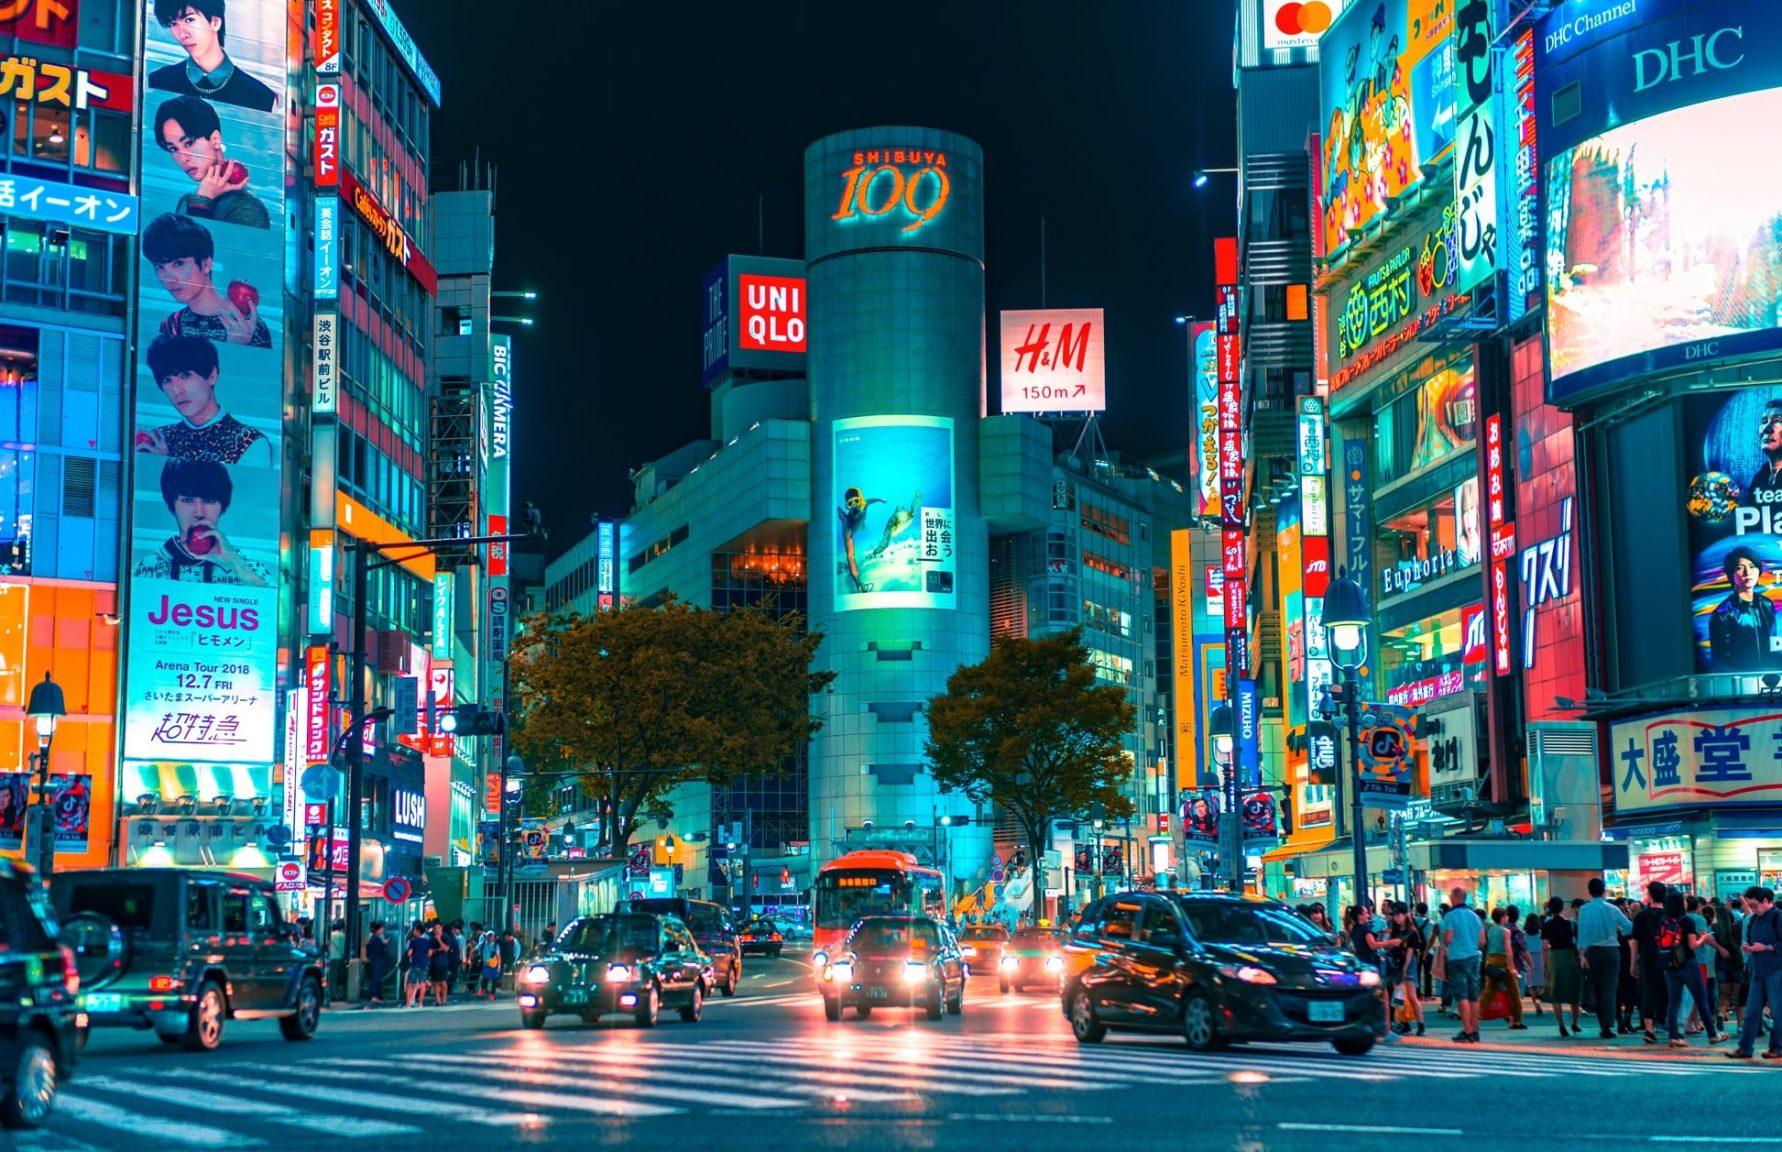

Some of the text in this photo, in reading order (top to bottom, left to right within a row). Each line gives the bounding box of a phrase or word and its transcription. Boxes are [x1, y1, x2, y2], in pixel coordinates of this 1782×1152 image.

[1545, 0, 1637, 54] DHC Channel
[325, 62, 337, 71] 8F
[1632, 26, 1744, 93] DHC
[0, 57, 108, 110] ガスト
[320, 127, 335, 175] ガスト
[852, 150, 947, 166] SHIBUYA
[831, 164, 950, 232] 109
[320, 207, 333, 288] 英会話イーオン
[748, 284, 799, 313] UNI
[748, 314, 805, 345] QLO
[318, 320, 332, 405] 渋谷駅前ビル
[1014, 321, 1092, 374] H&M
[1685, 341, 1719, 360] DHC
[493, 345, 514, 458] BIC CAMERA
[925, 518, 952, 530] 世界に
[925, 531, 952, 544] 出会
[925, 546, 952, 558] おう
[1306, 560, 1327, 574] JTB
[1383, 546, 1454, 593] Euphoria
[148, 594, 260, 631] Jesus
[214, 596, 259, 605] NEW SINGLE
[1177, 565, 1189, 677] Matsumoto KiYoshi
[198, 633, 246, 648] ヒモメン
[155, 660, 250, 675] Arena Tour 2018
[176, 674, 233, 690] 12.7 FRI
[144, 691, 258, 706] さいたまスーパーアリーナ
[310, 679, 325, 753] サンドラッグ
[1241, 692, 1253, 739] MIZUHO
[151, 712, 248, 745] 超特急
[1316, 735, 1335, 769] HUB
[1620, 724, 1782, 793] 大盛堂
[396, 789, 425, 829] LUSH
